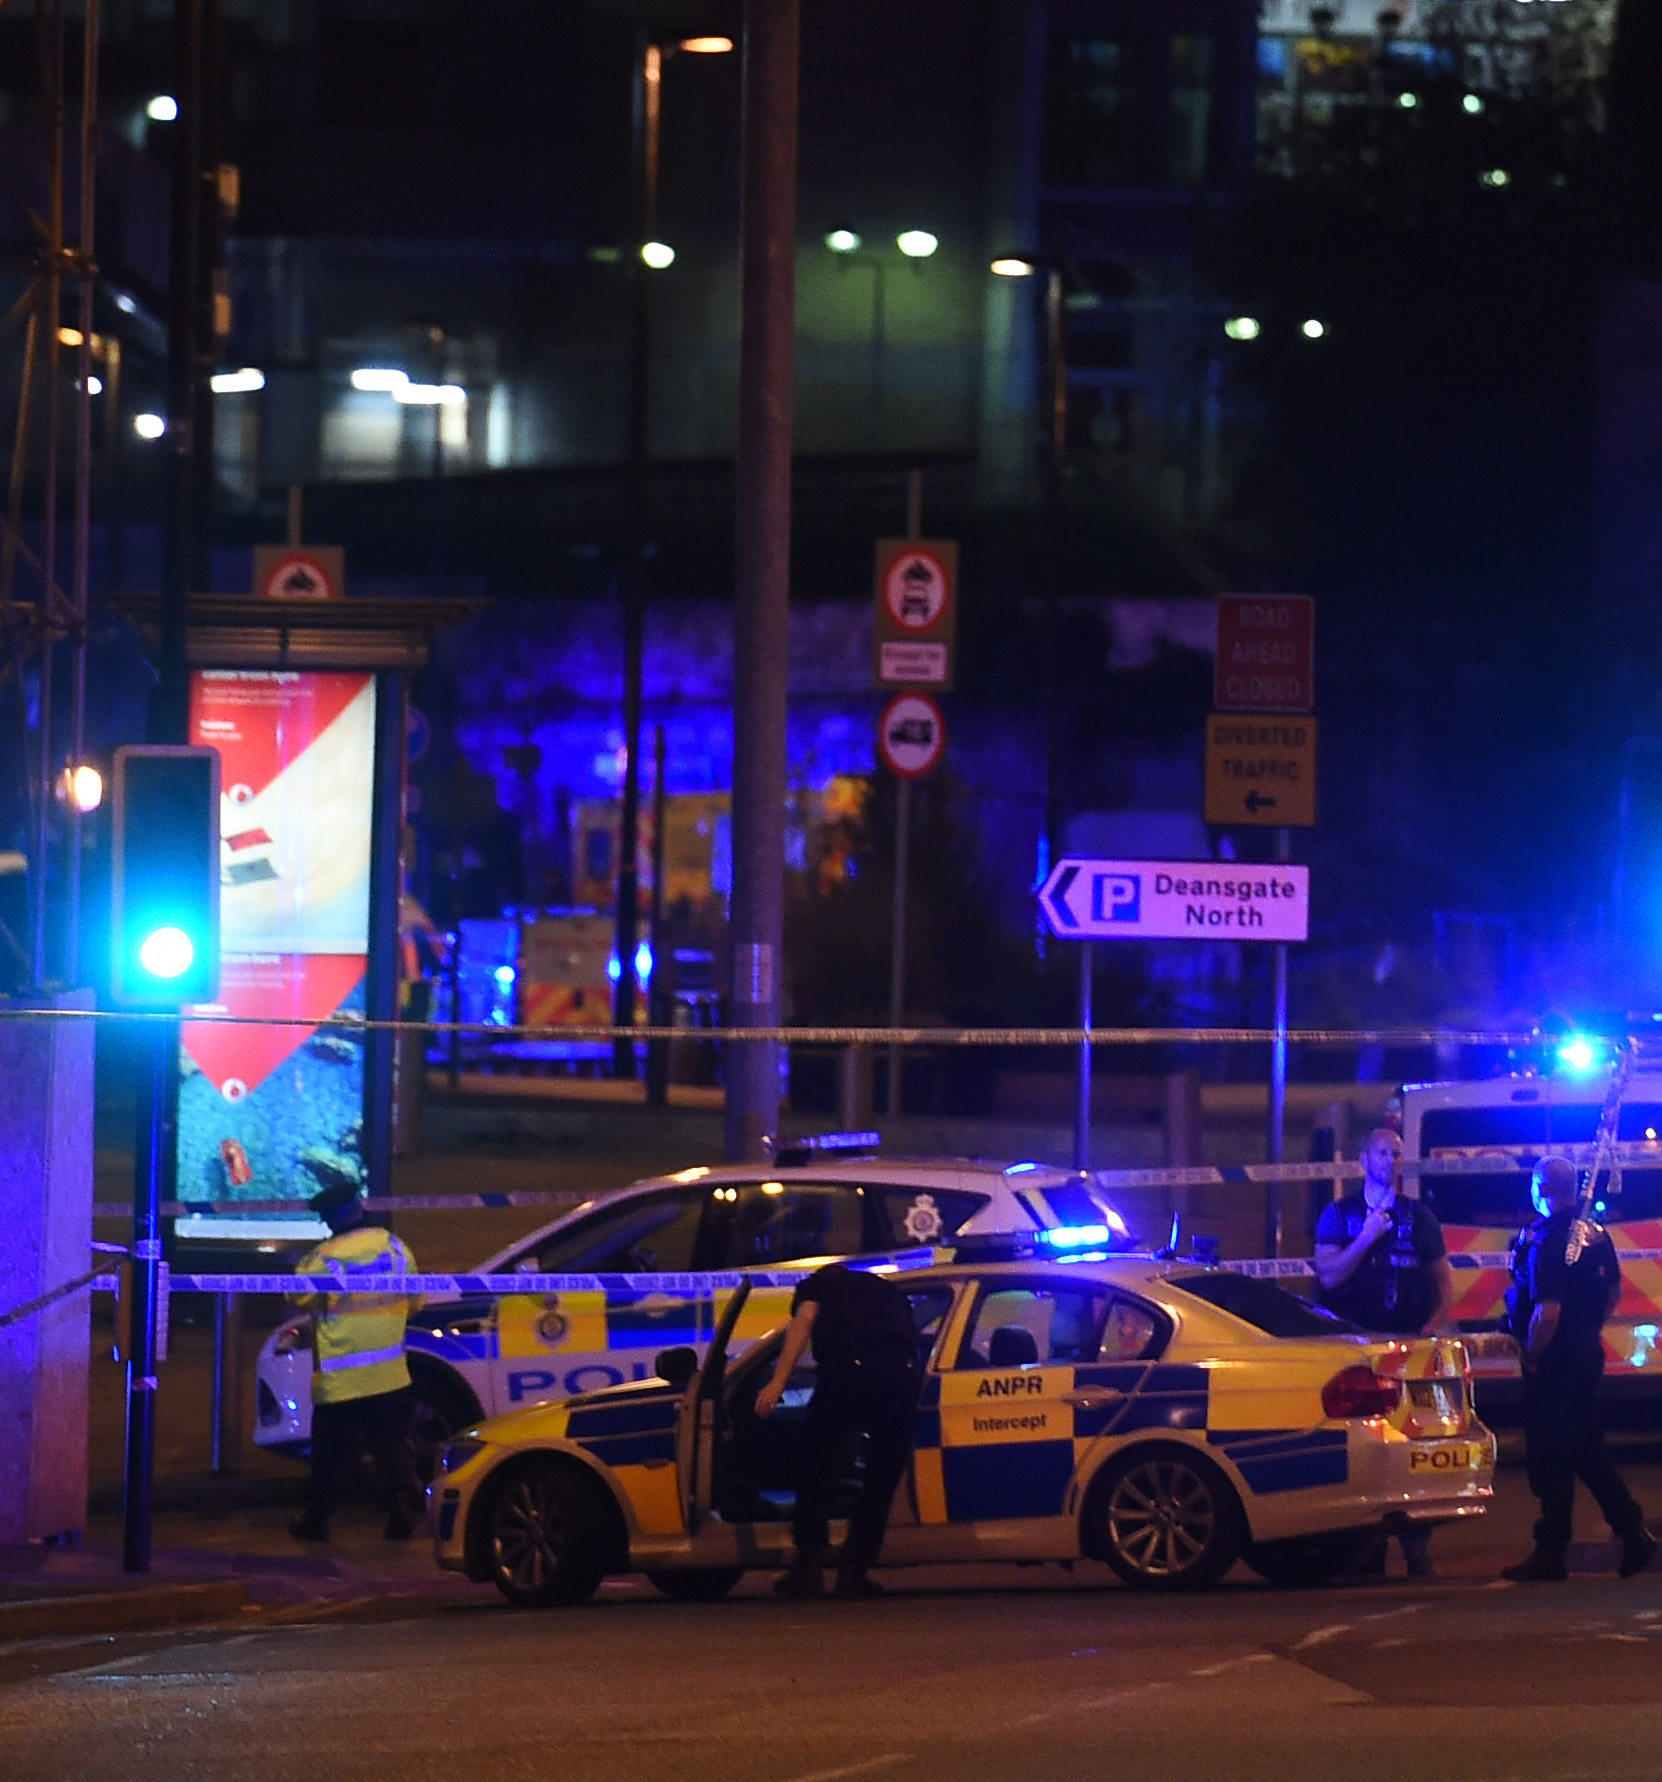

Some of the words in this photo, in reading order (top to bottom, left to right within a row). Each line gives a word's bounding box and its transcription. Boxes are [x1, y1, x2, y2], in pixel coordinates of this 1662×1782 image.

[1214, 726, 1306, 746] DIVERTED
[1222, 759, 1298, 781] TRAFFIC
[1155, 873, 1295, 900] Deansgate
[1186, 904, 1263, 926] North
[977, 1375, 1043, 1397] ANPR
[973, 1413, 1046, 1432] Intercept
